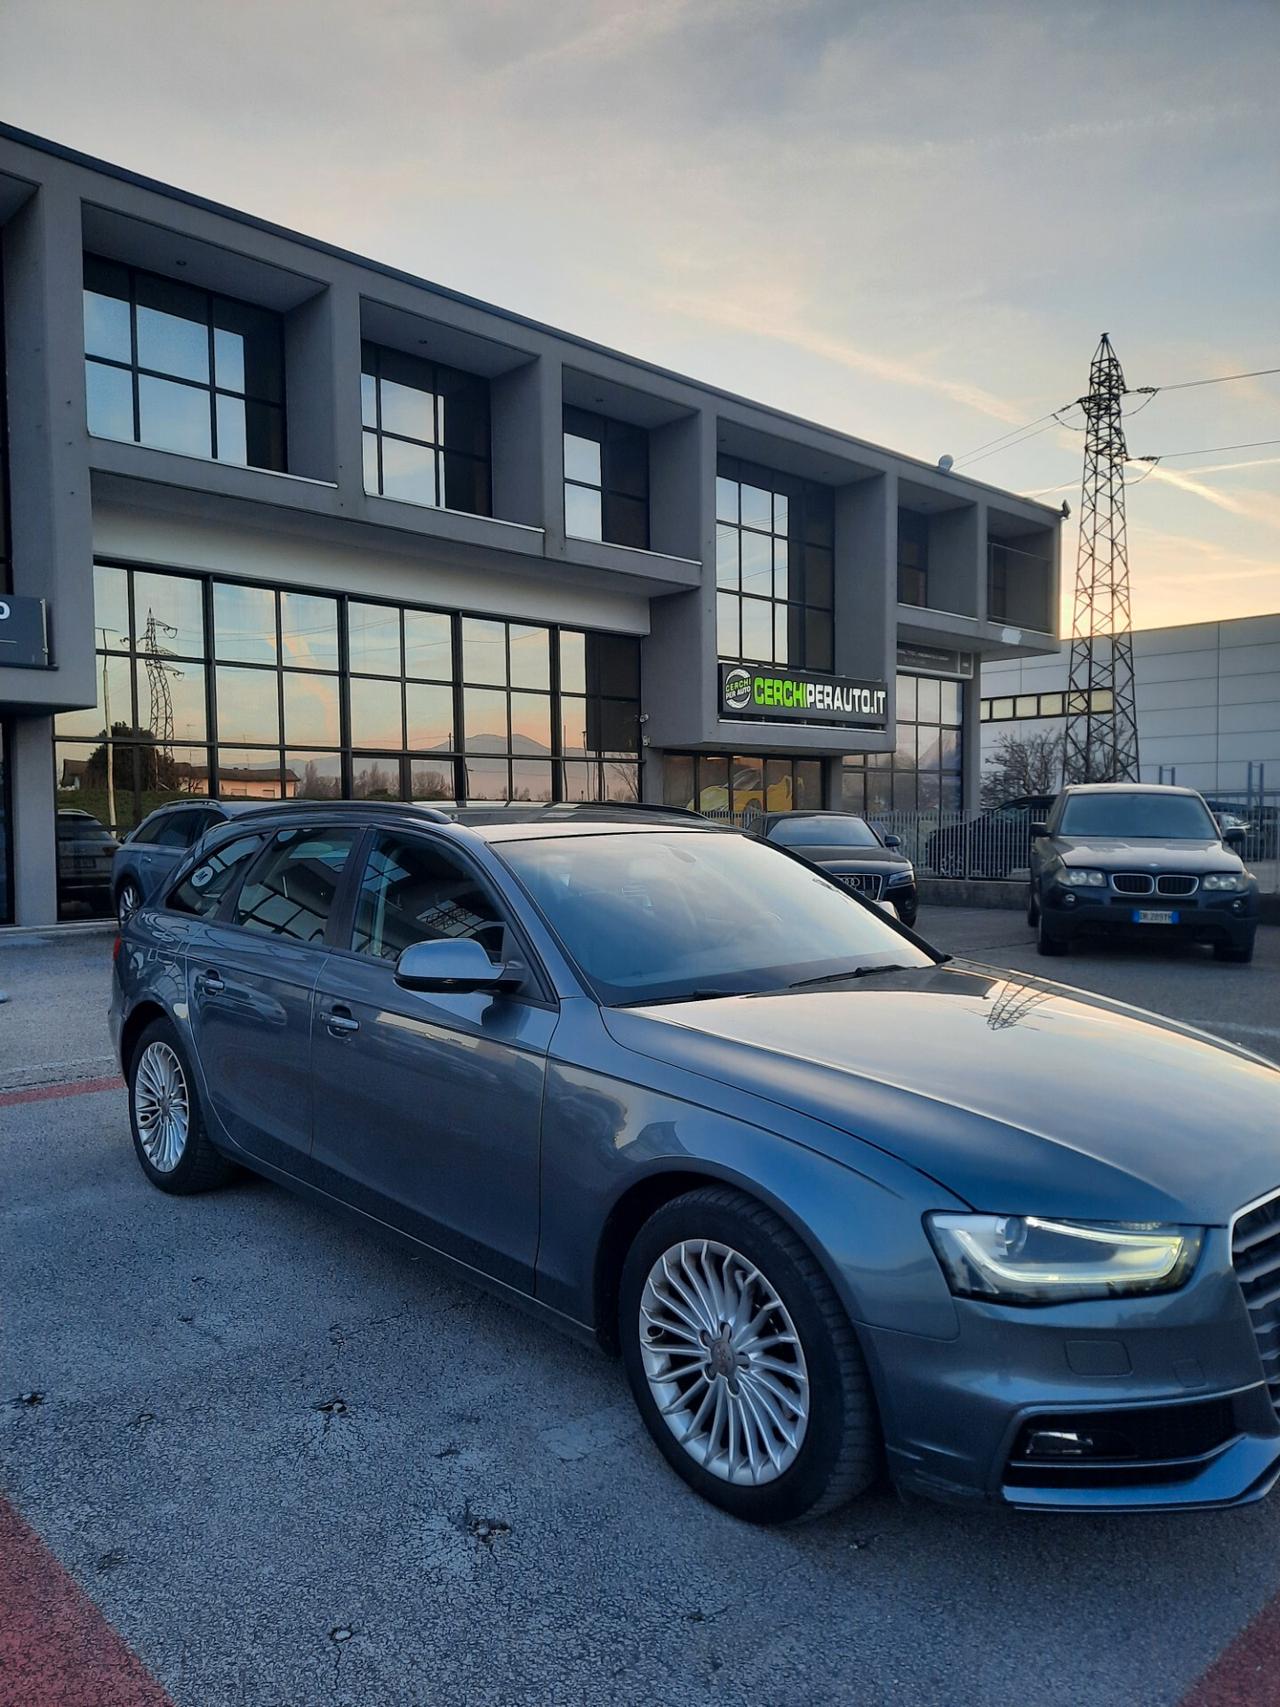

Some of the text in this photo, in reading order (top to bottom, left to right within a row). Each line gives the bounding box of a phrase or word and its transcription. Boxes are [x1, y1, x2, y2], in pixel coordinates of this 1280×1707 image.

[725, 678, 751, 692] CERCHI
[725, 686, 751, 700] PER AUTO
[754, 677, 886, 714] CERCHIPERAUTO.IT
